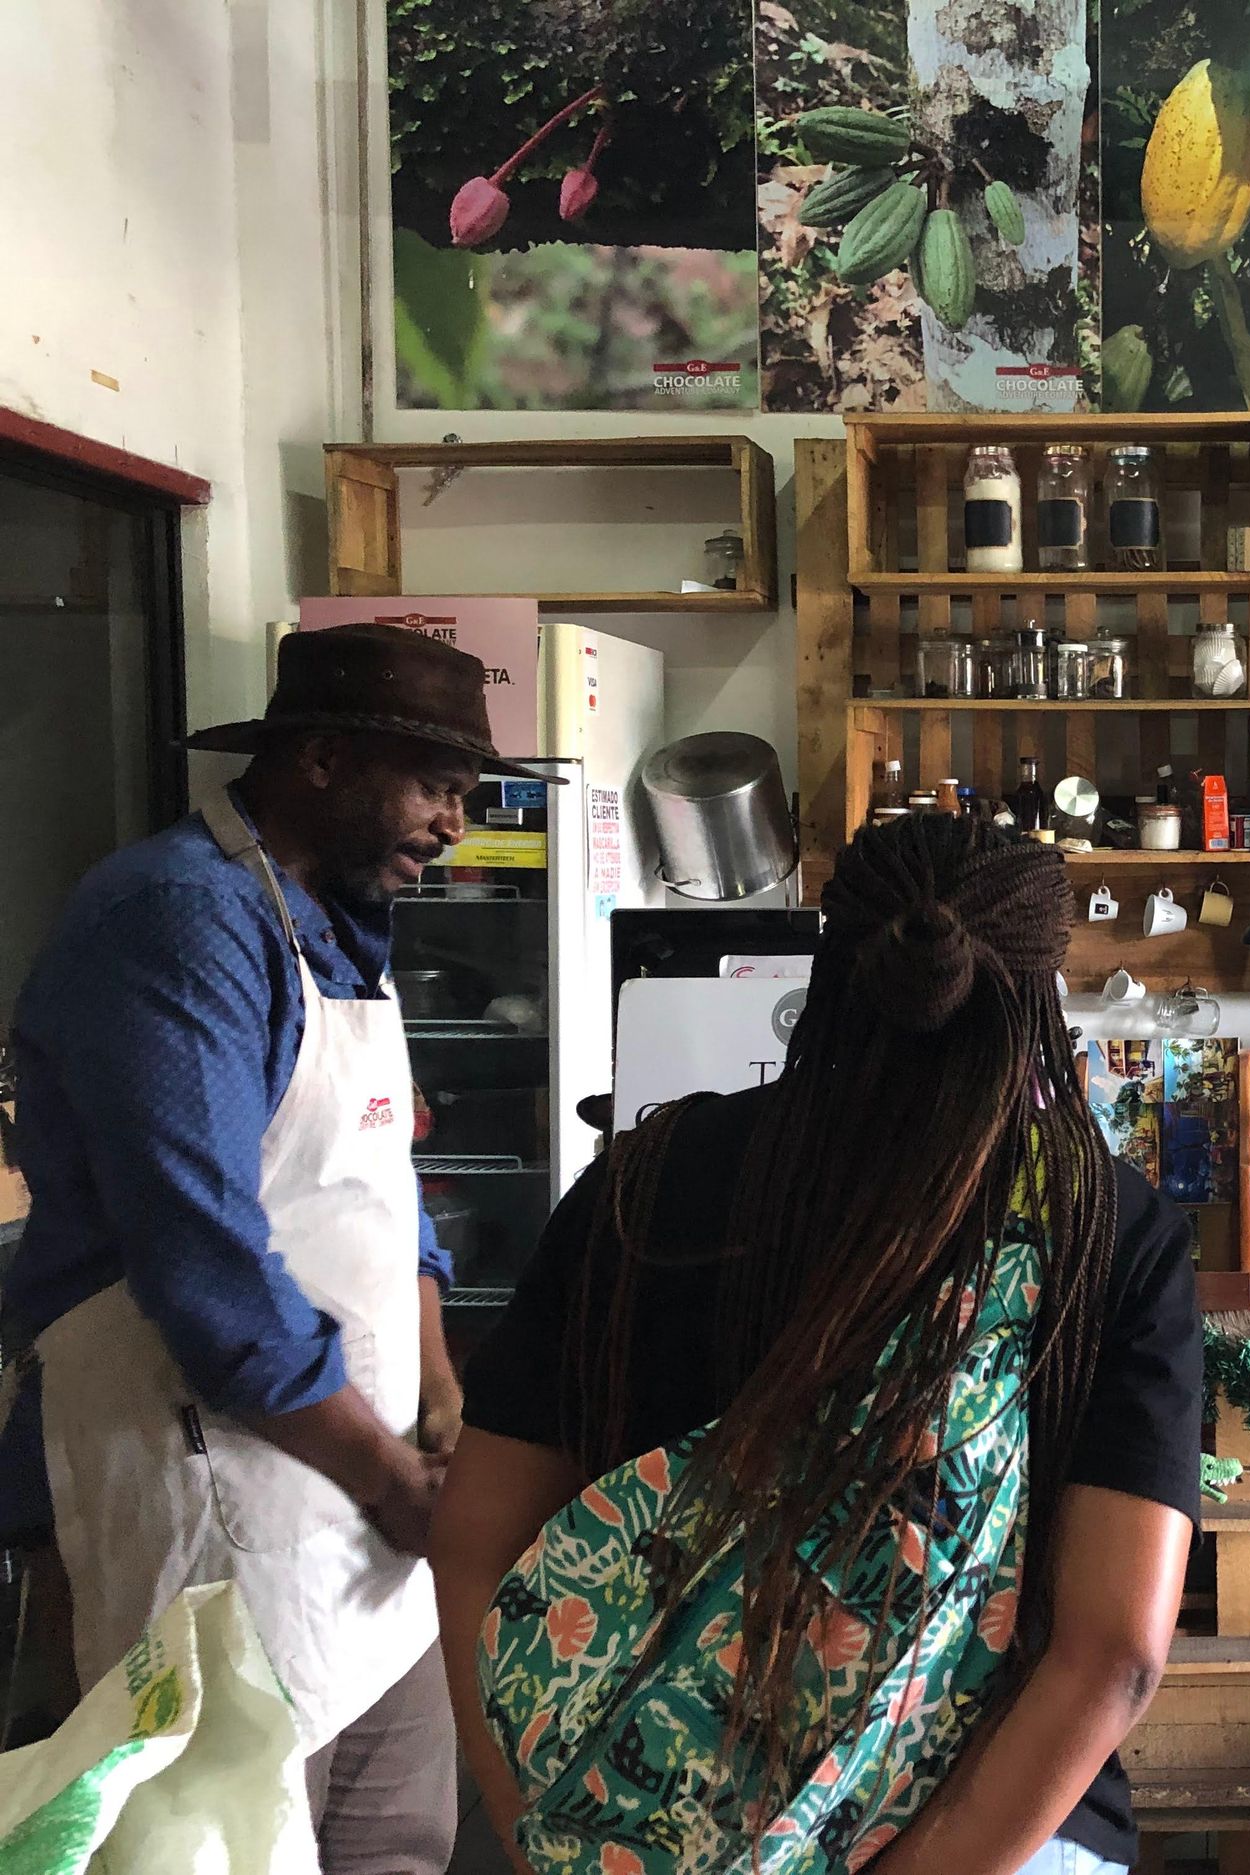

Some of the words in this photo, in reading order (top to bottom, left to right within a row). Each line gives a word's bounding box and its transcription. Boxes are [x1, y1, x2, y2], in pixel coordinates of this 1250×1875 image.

[654, 376, 741, 388] CHOCOLATE
[996, 380, 1084, 391] CHOCOLATE
[416, 629, 457, 640] OLATE
[484, 668, 516, 686] ETA.
[591, 788, 619, 805] ESTIMADO
[591, 804, 619, 820] CLIENTE
